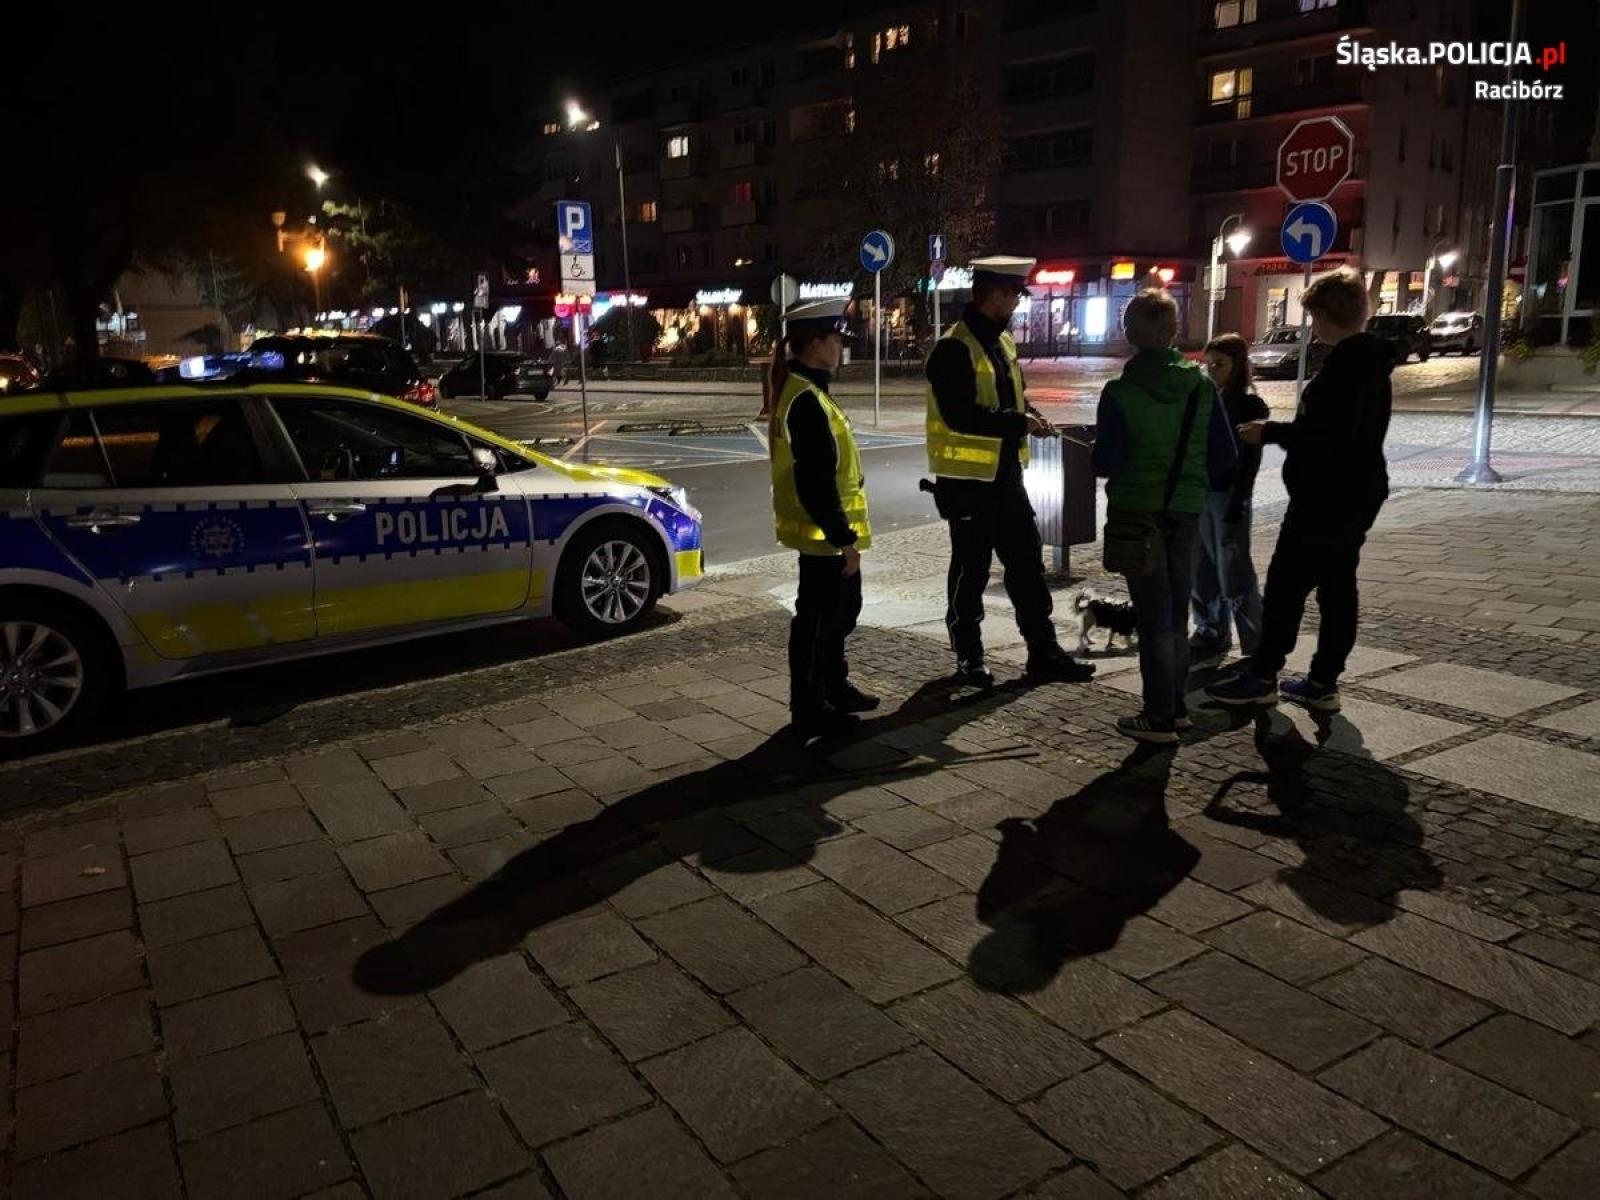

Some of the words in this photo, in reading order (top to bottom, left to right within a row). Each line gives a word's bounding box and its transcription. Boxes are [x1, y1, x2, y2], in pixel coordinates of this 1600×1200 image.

[1286, 146, 1344, 176] STOP
[566, 206, 584, 239] P
[376, 507, 509, 545] POLICJA
